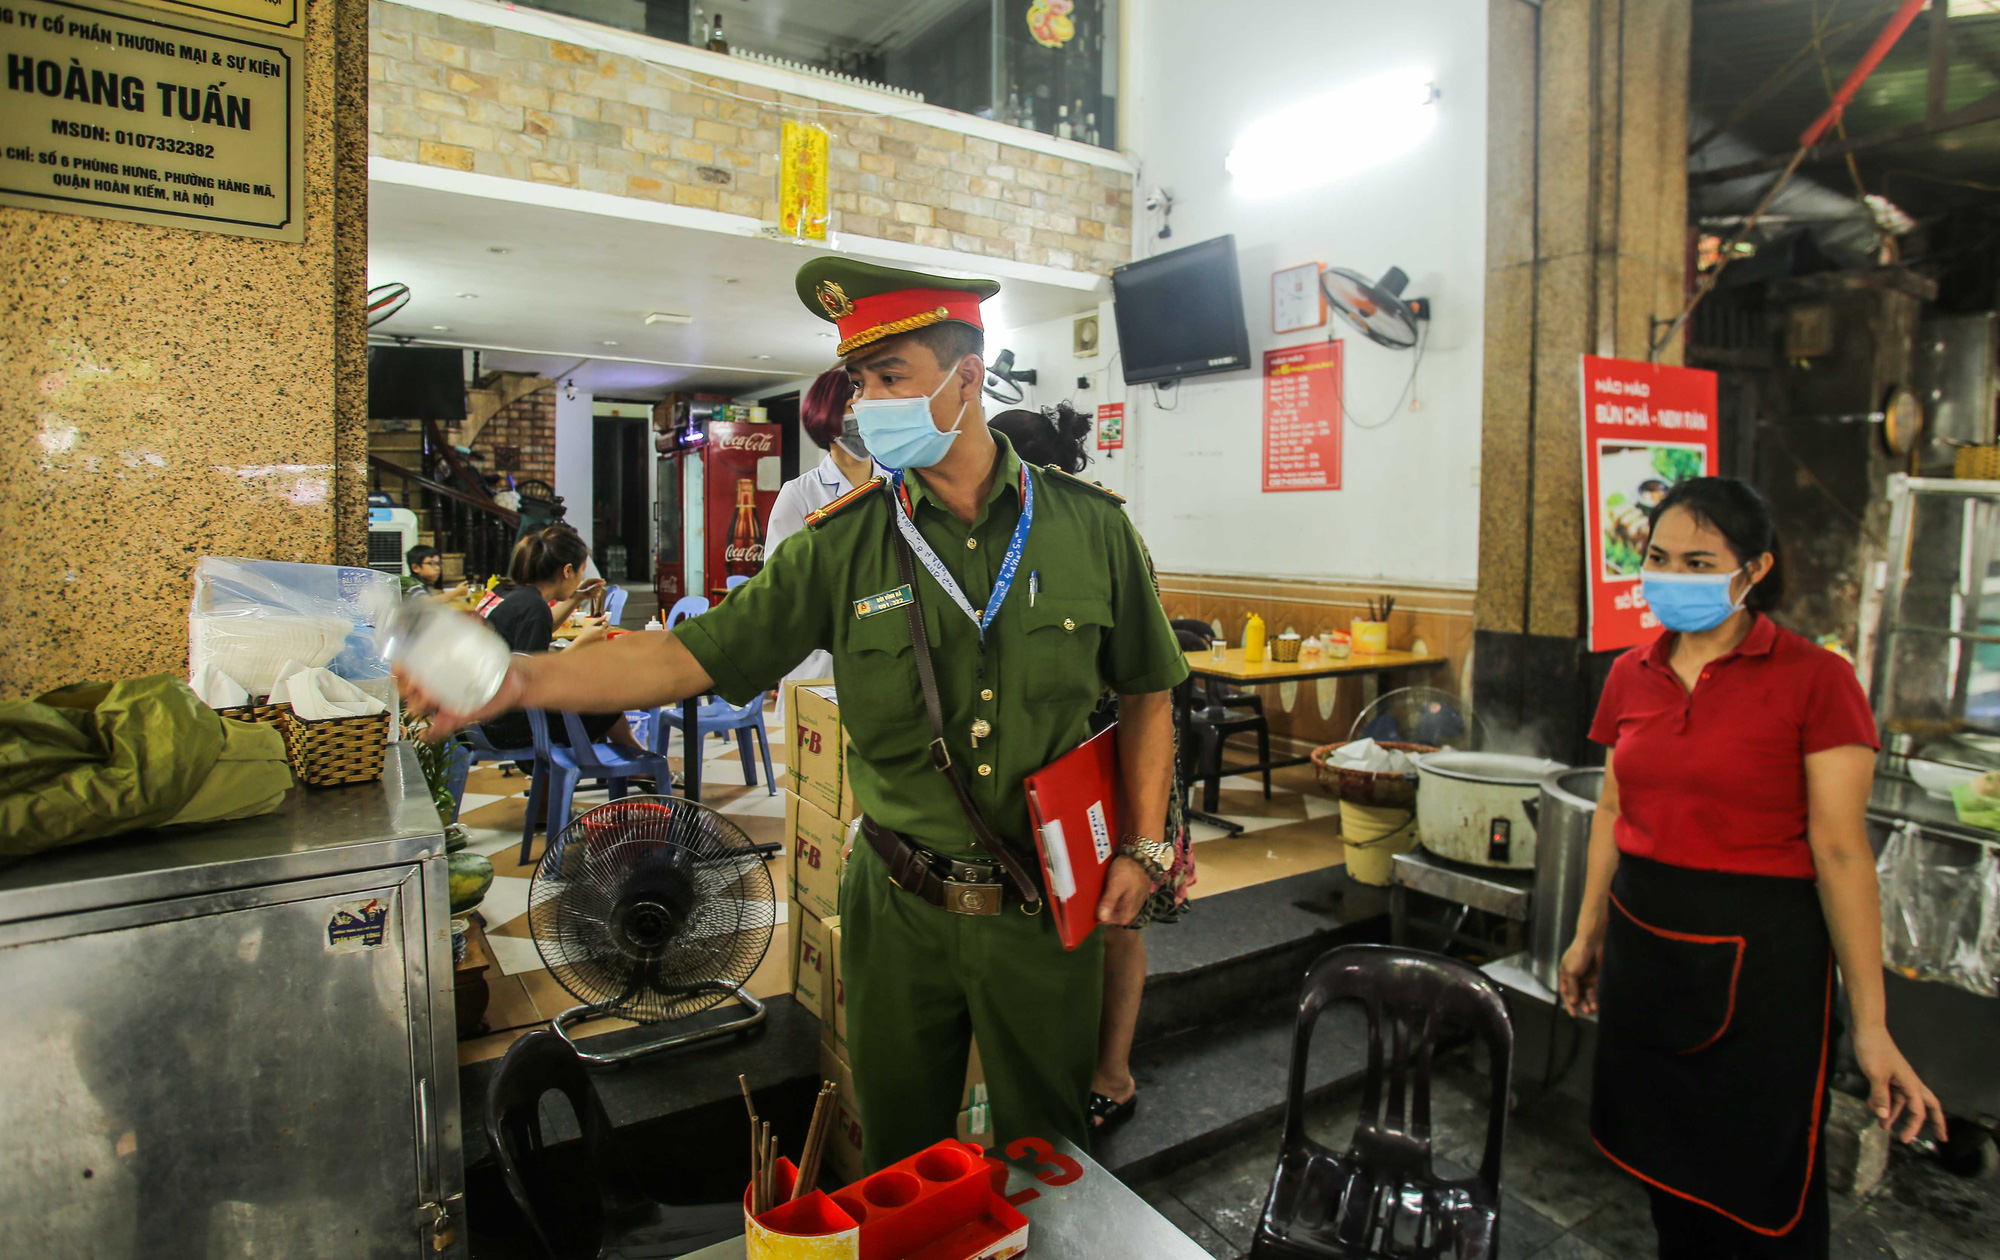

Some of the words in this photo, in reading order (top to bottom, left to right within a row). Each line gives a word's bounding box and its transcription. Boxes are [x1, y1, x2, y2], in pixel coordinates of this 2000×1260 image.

[18, 11, 37, 29] TY
[116, 32, 175, 57] THƯƠNG
[179, 45, 207, 65] MẠI
[211, 52, 222, 66] &
[226, 55, 246, 73] SỰ
[249, 59, 280, 78] KIỆN
[8, 53, 145, 113] HOÀNG
[157, 81, 251, 131] TUẤN
[51, 118, 110, 142] MSDN:
[115, 130, 214, 159] 0107332382
[61, 156, 70, 167] 6
[164, 171, 214, 189] PHƯỜNG
[217, 178, 250, 194] HÀNG
[94, 178, 130, 194] HOÀN
[173, 189, 190, 203] HÀ
[193, 193, 214, 208] NỘI
